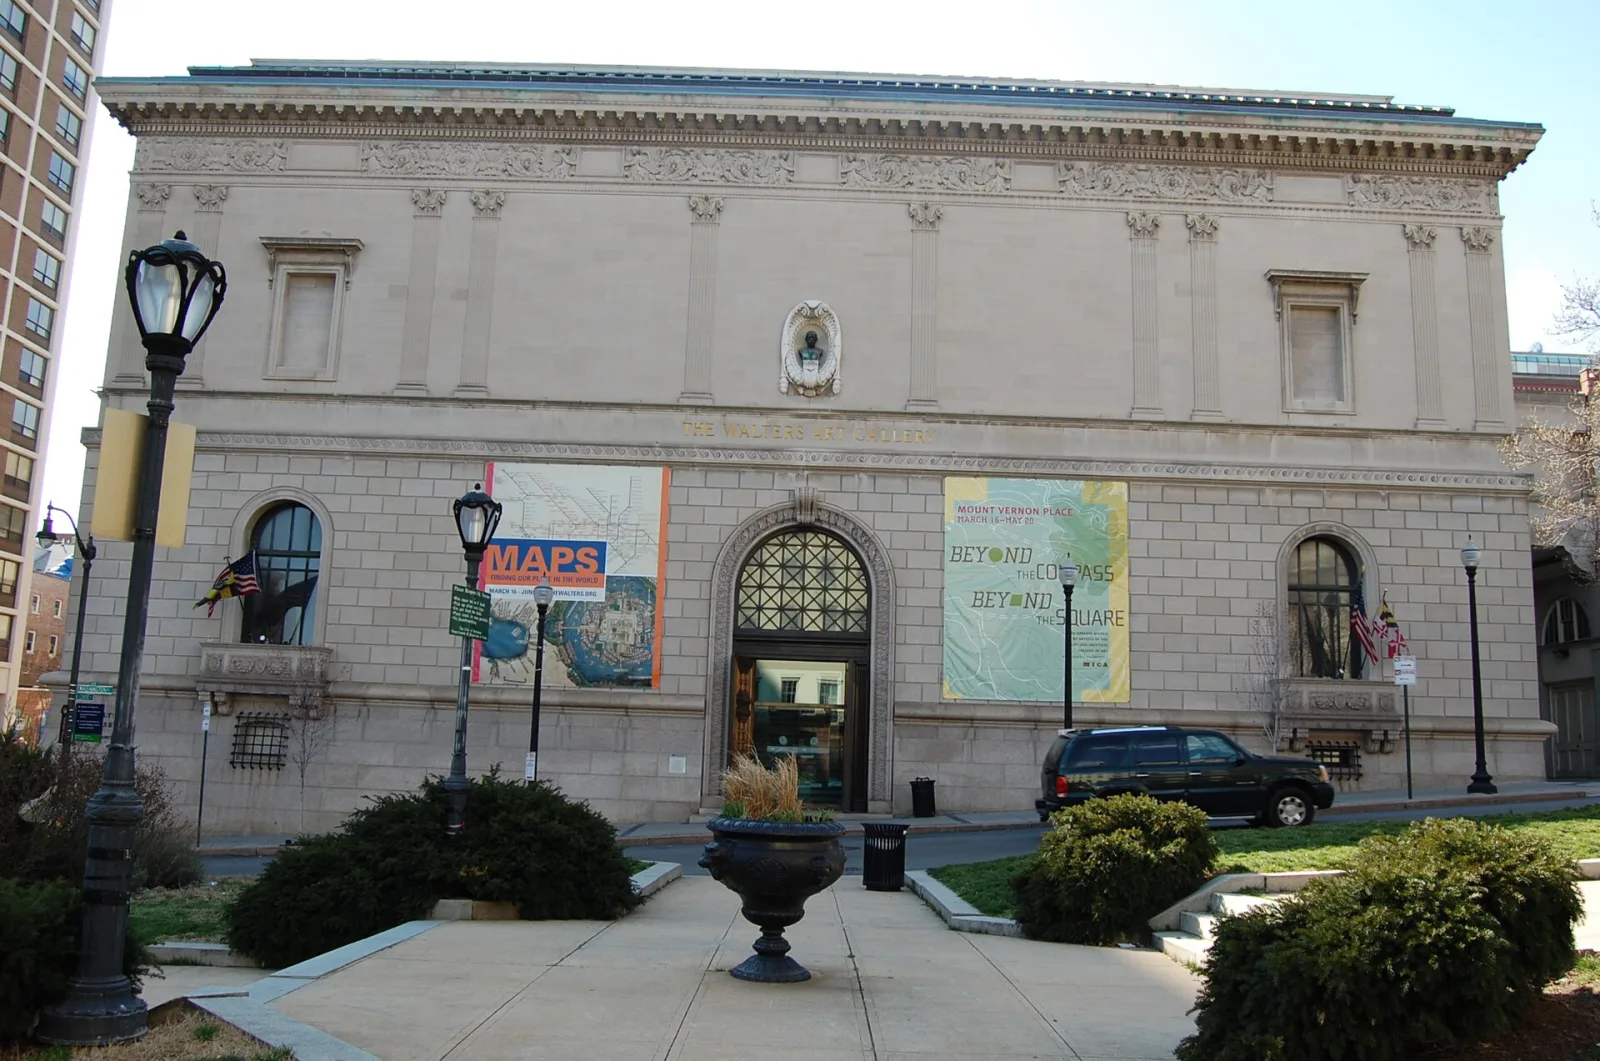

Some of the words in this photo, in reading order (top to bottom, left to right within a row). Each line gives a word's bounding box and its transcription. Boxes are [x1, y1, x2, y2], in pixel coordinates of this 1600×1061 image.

[682, 421, 715, 438] THE
[723, 422, 805, 440] WALTERS
[812, 425, 847, 442] ART
[854, 427, 937, 444] GALLERY
[957, 505, 994, 515] MOUNT
[998, 506, 1039, 516] VERNON
[1043, 507, 1074, 517] PLACE
[957, 515, 988, 524] MARCH
[1024, 516, 1034, 525] 20
[488, 544, 599, 574] MAPS
[517, 574, 531, 582] OUR
[553, 575, 561, 583] IN
[562, 576, 573, 584] THE
[575, 577, 599, 585] WORLD
[1016, 570, 1035, 580] THE
[1036, 563, 1114, 582] COASS
[552, 590, 597, 598] HEWALTERS.ORG
[1036, 615, 1055, 625] THE
[1055, 608, 1124, 627] SQUARE
